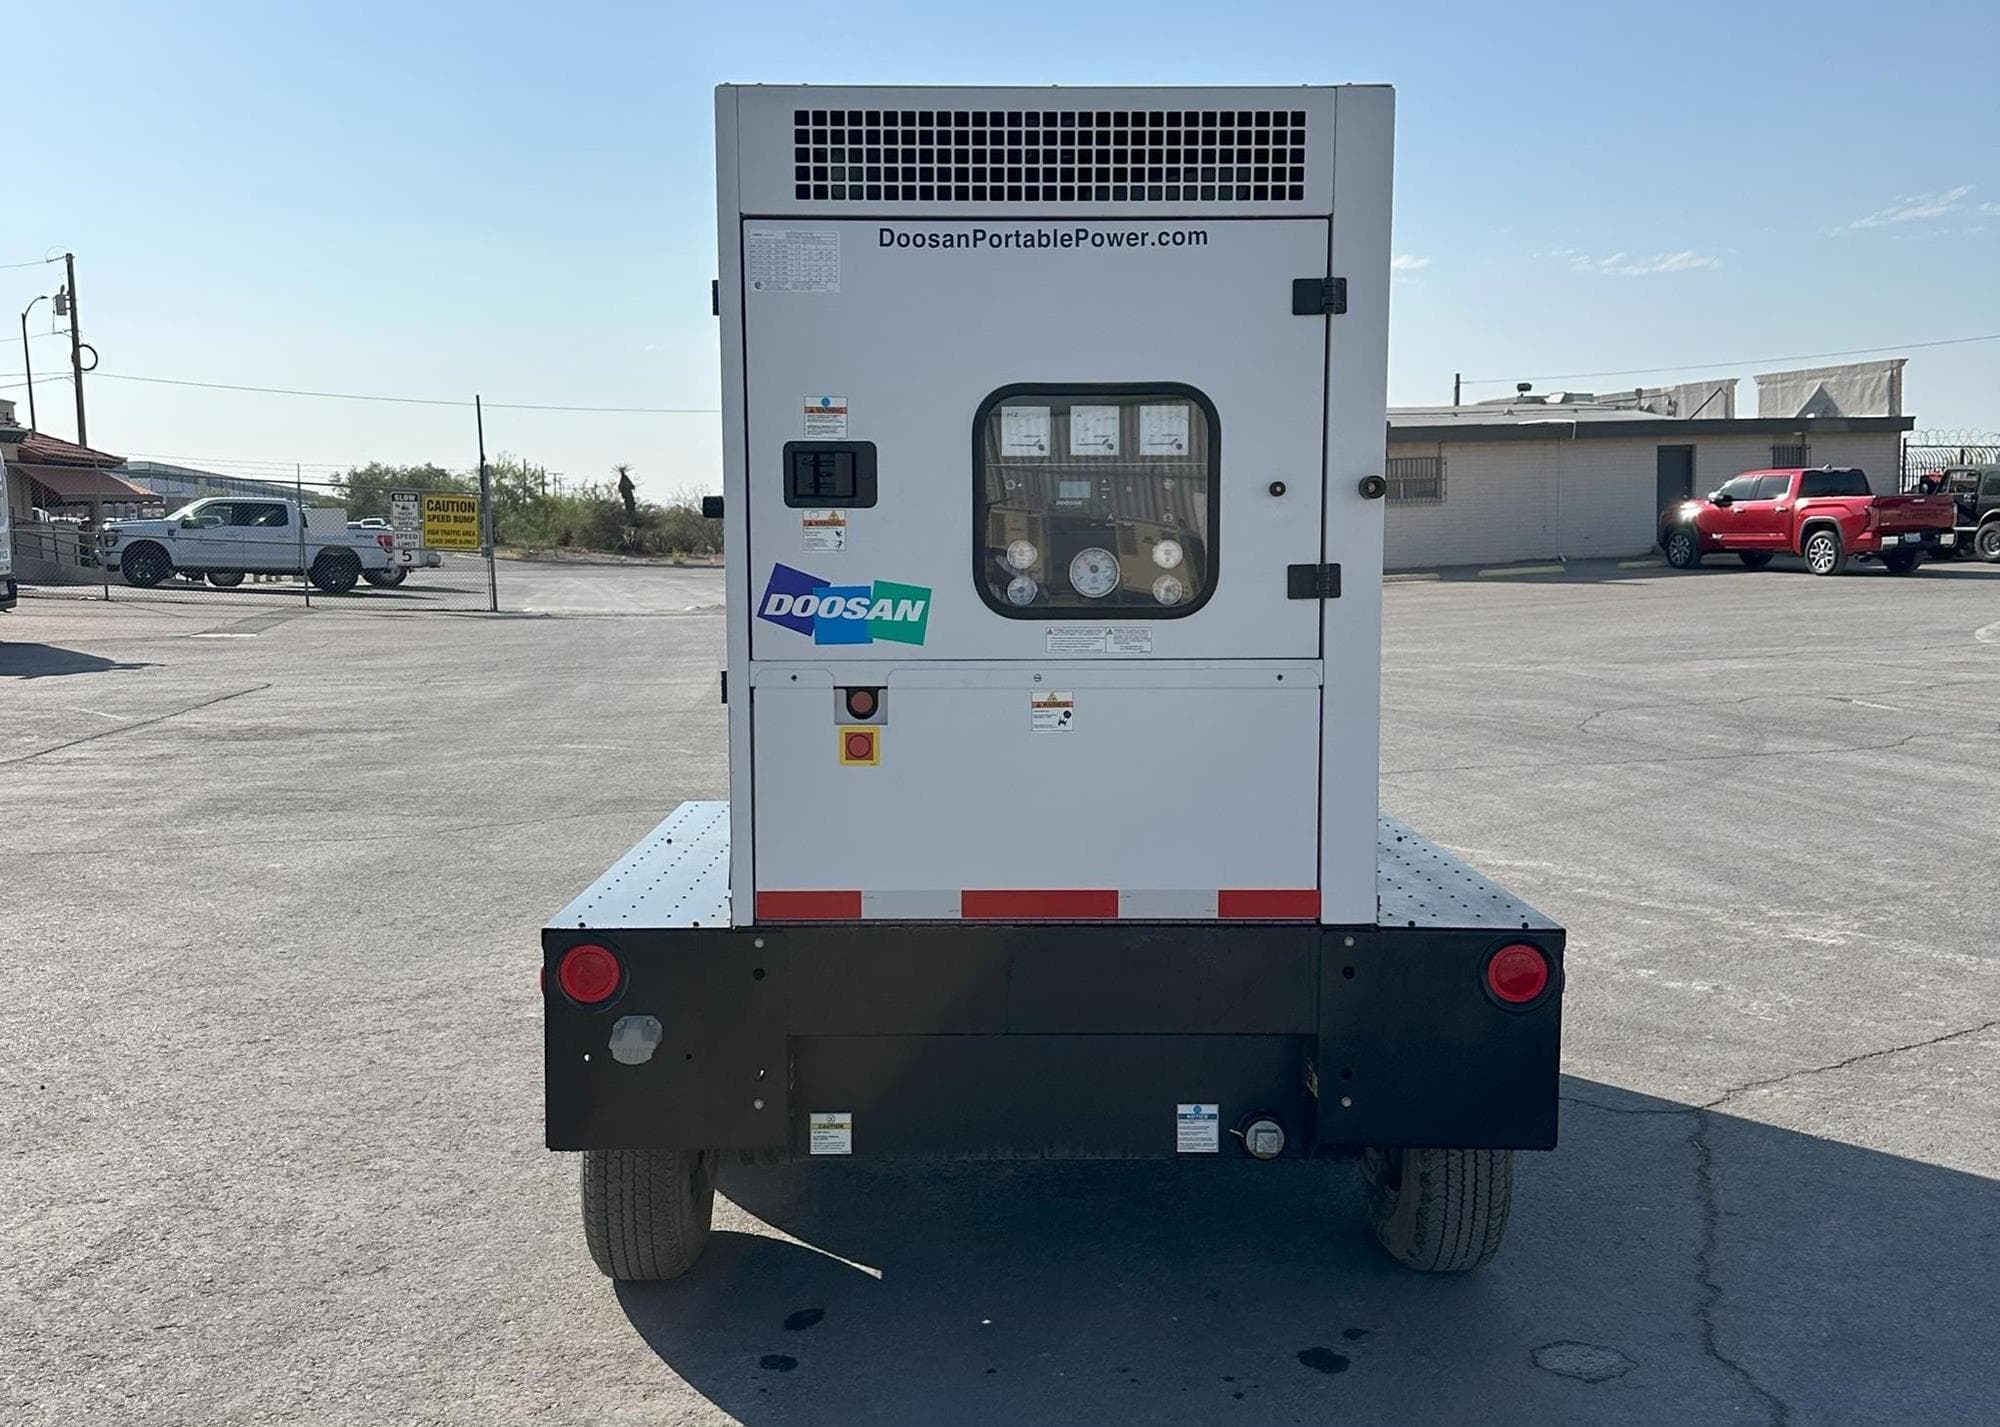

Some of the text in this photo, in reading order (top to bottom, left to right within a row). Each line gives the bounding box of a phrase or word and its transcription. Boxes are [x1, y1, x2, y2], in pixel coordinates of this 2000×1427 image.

[878, 228, 1208, 248] DoosanPortablePower.com
[426, 499, 475, 513] CAUTION
[427, 514, 476, 523] SPEED BUMP
[402, 549, 412, 562] 5
[763, 593, 926, 622] DOOSAN
